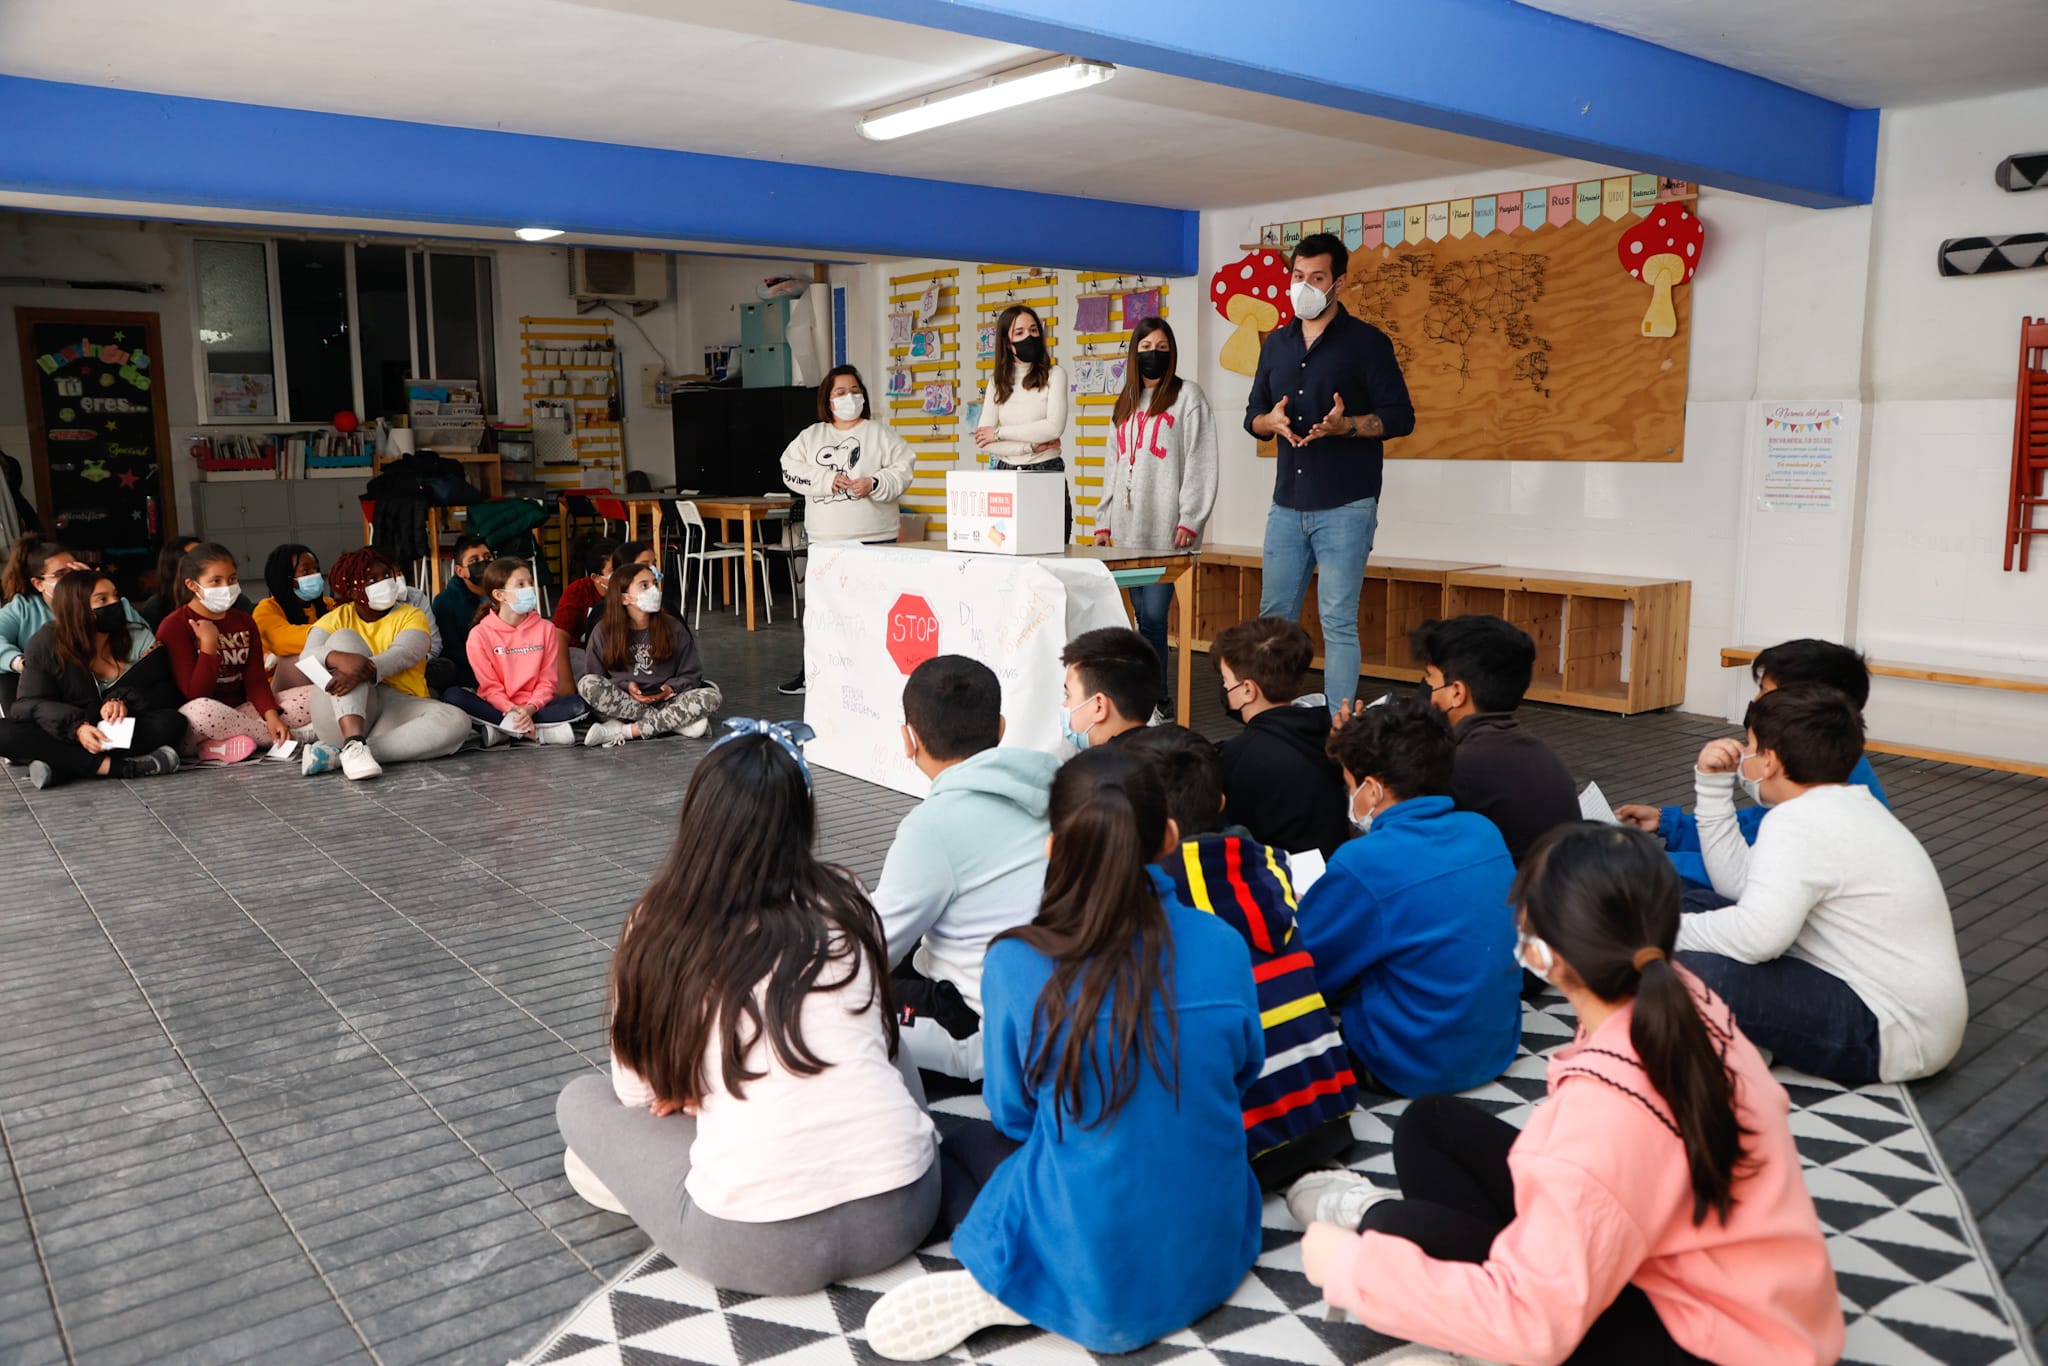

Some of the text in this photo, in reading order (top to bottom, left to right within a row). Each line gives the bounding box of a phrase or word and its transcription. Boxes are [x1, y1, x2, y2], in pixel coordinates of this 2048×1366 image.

[1551, 195, 1570, 206] Rus
[1116, 411, 1175, 463] NYC
[951, 490, 987, 517] VOTA
[959, 601, 974, 626] DI
[893, 613, 938, 642] STOP
[971, 628, 984, 642] NO
